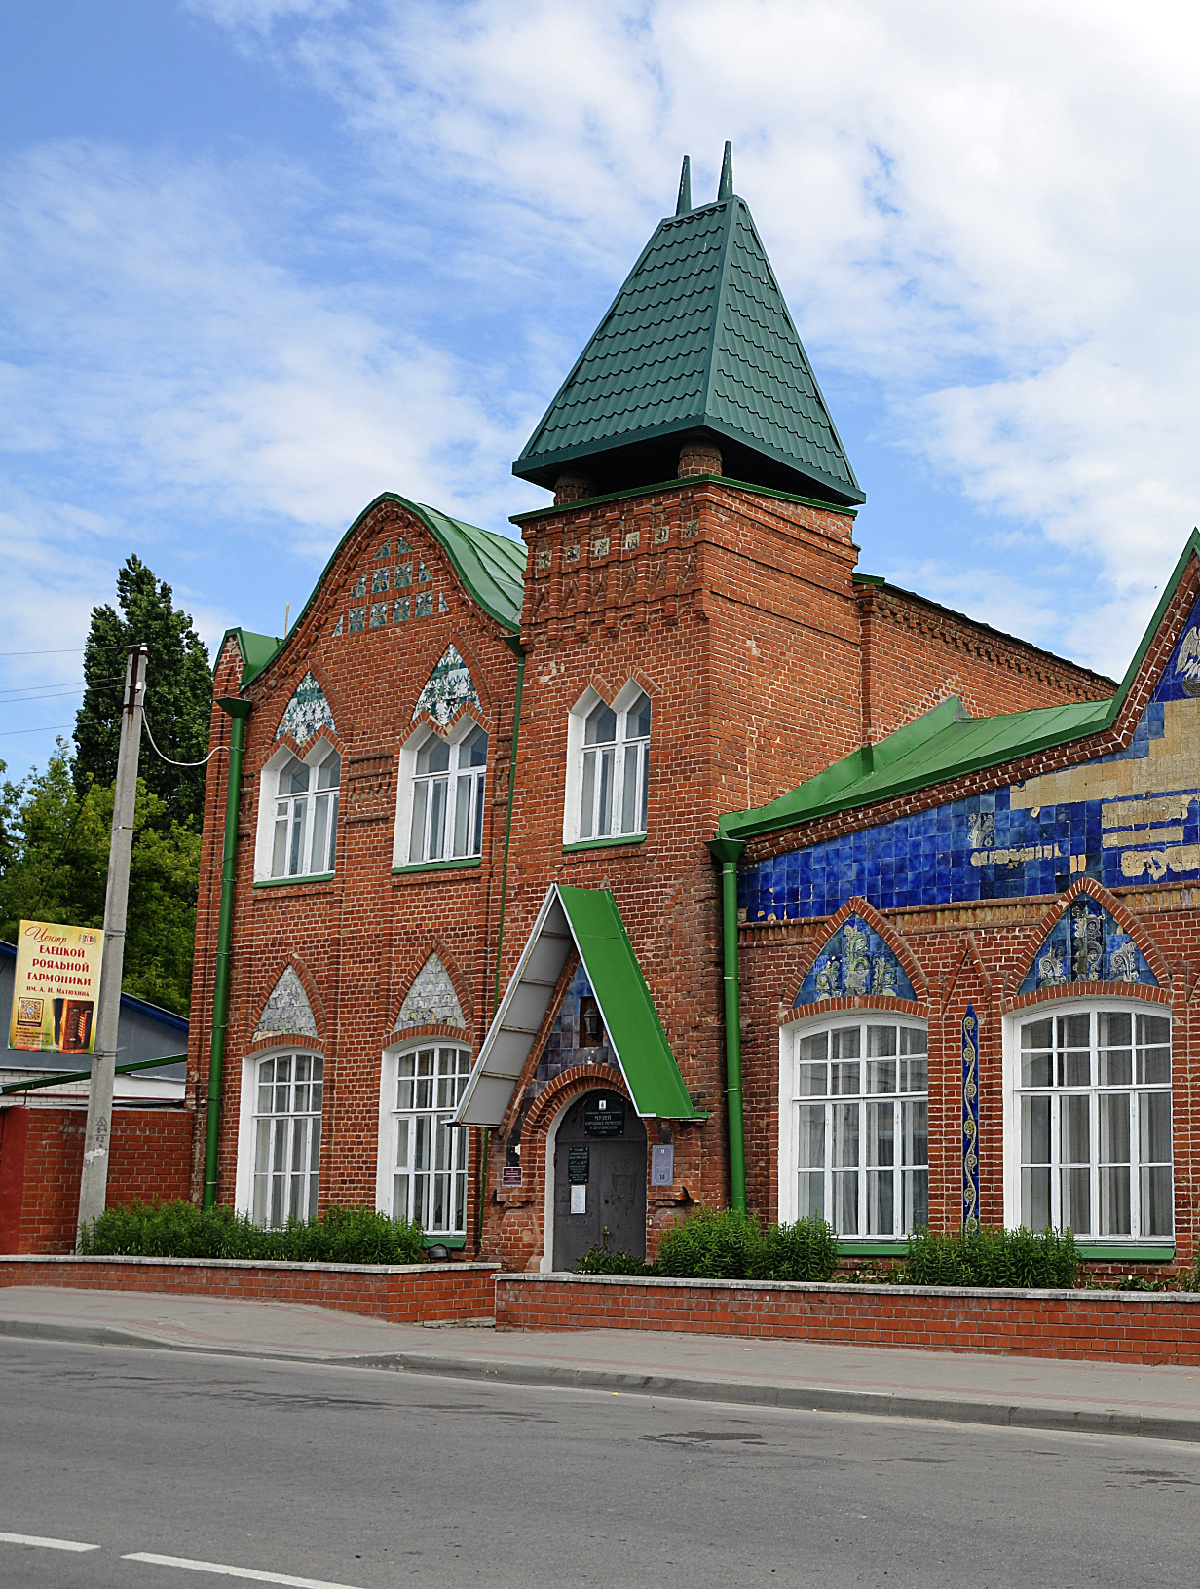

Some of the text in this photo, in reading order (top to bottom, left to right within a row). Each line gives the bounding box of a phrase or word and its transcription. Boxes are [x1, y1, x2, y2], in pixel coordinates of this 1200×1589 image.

[39, 944, 86, 958] ЕЛЕЦКОЙ
[32, 958, 90, 973] РОЯЛЬНОЙ
[27, 971, 92, 986] ГАРМОНИКИ
